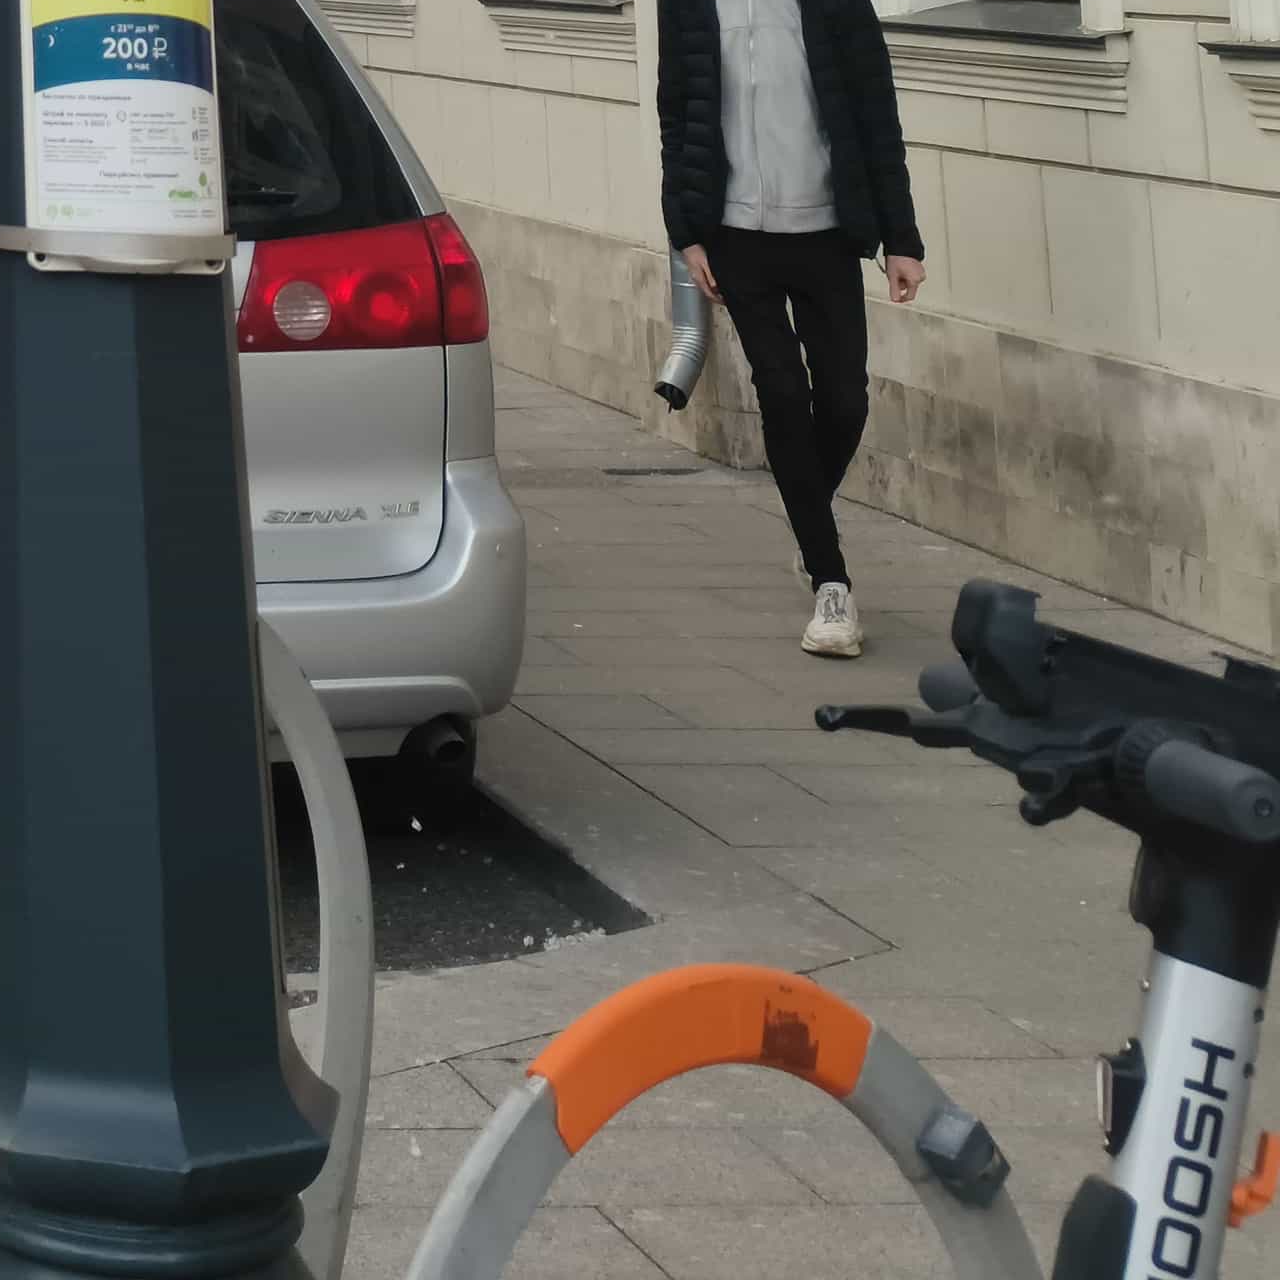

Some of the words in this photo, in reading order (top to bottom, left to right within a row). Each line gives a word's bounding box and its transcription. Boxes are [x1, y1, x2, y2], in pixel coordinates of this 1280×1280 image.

[102, 37, 148, 59] 200
[263, 506, 369, 524] SIENNA
[1148, 1038, 1236, 1280] OOSH
